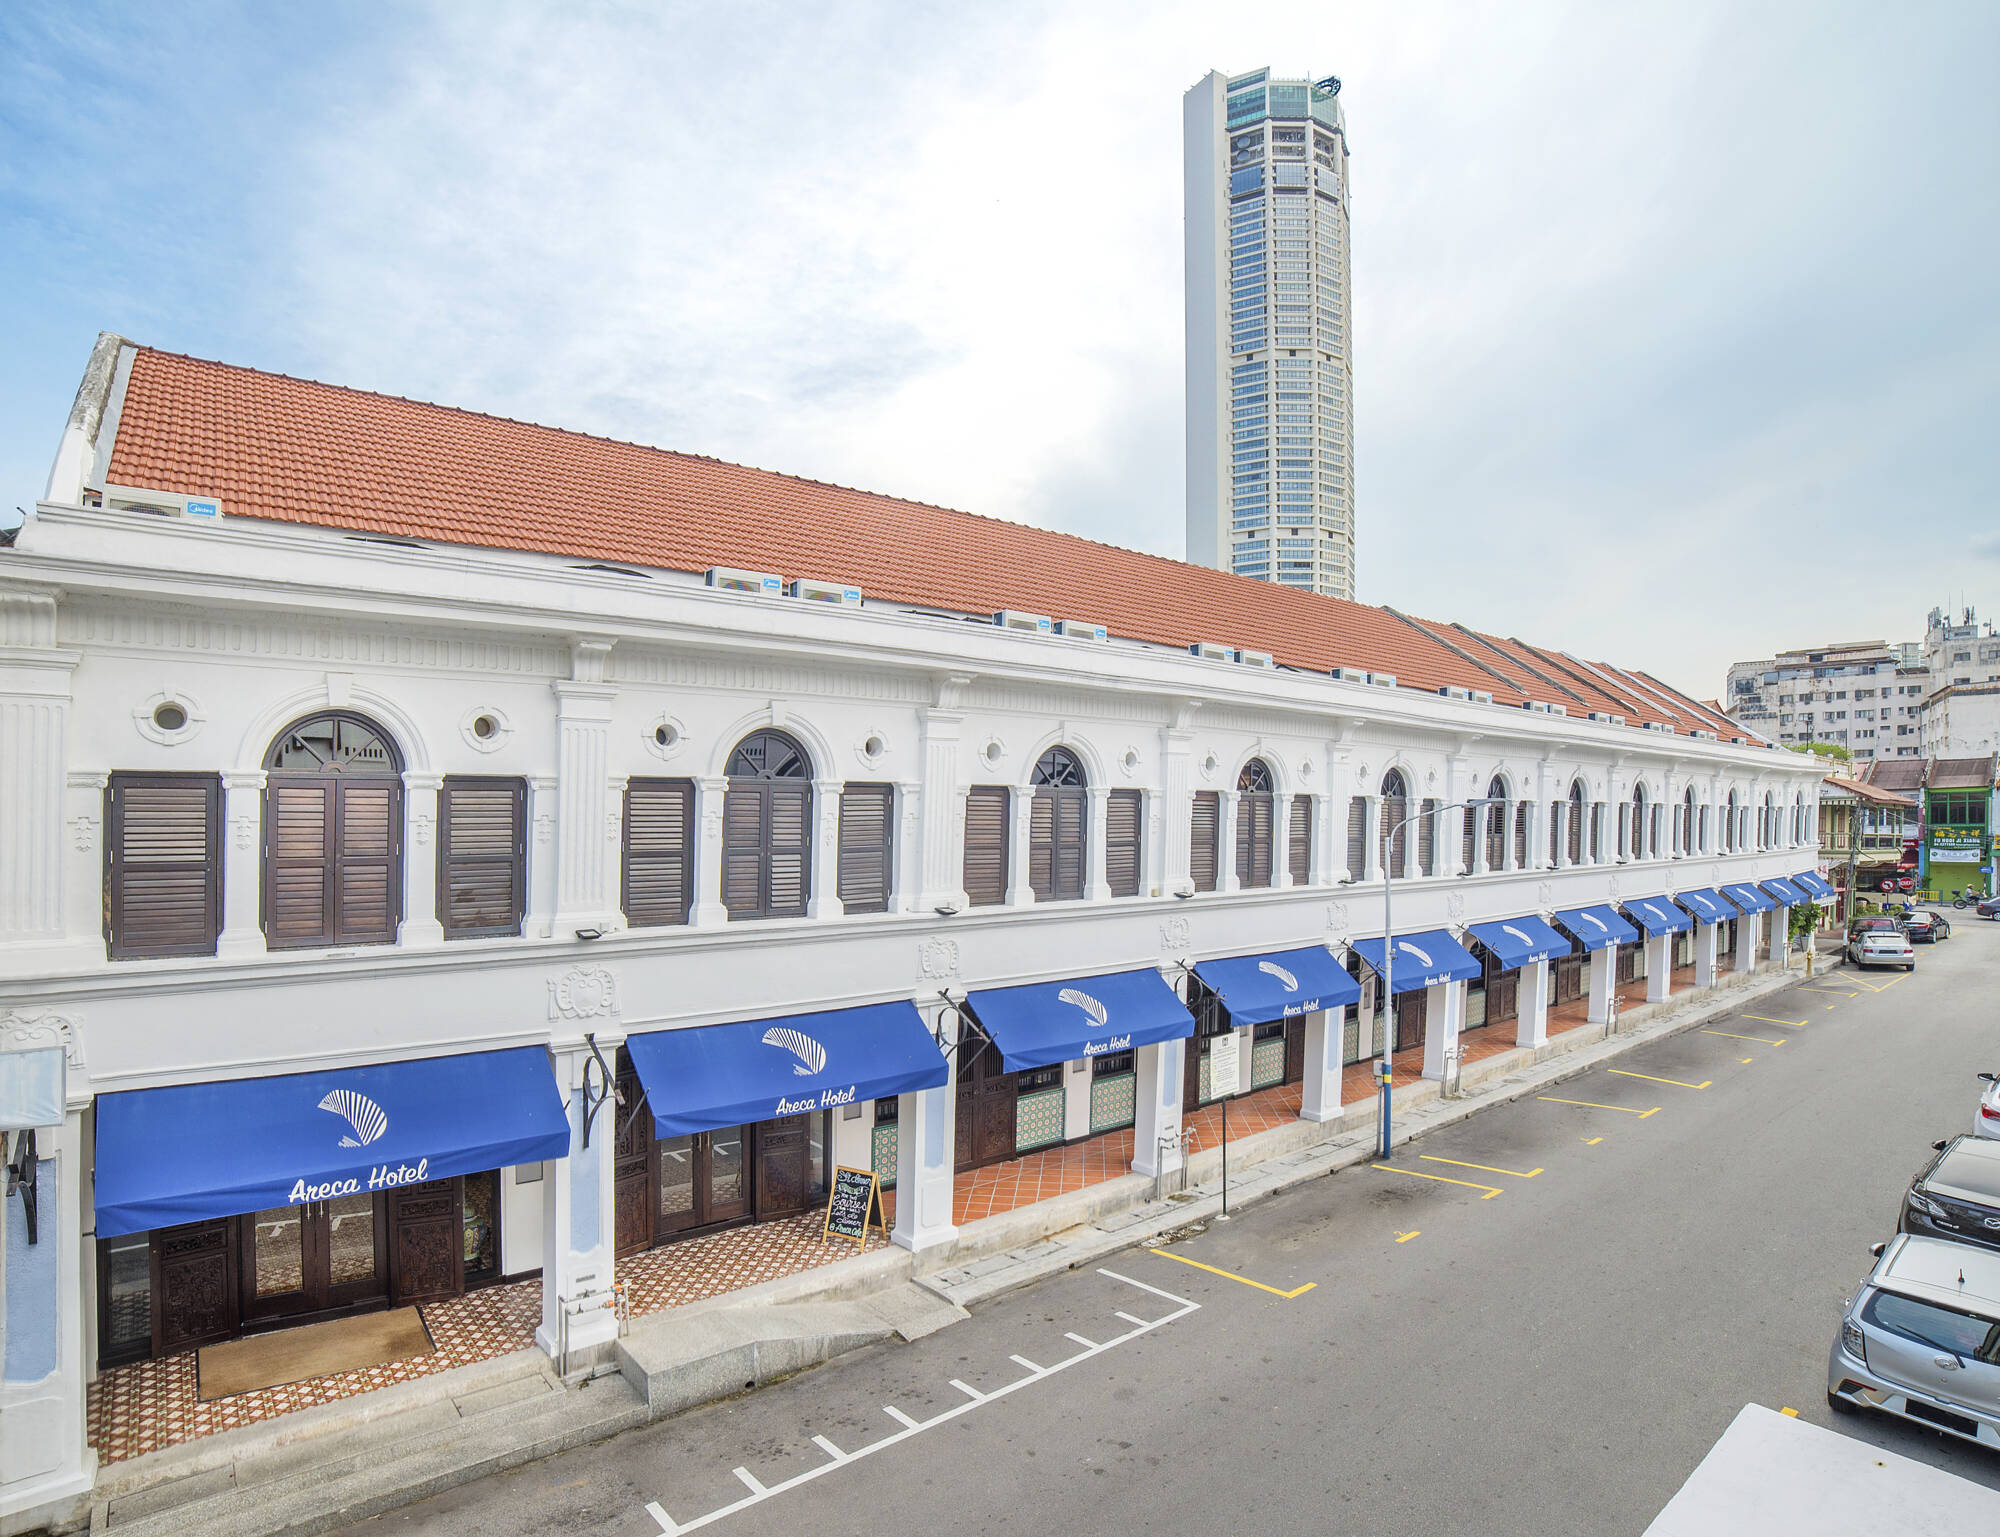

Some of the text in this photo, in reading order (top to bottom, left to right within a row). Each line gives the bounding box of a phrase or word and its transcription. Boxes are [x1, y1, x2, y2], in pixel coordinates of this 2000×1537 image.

[1303, 997, 1319, 1012] Hotel
[1083, 1033, 1131, 1056] Areca Hotel
[776, 1084, 856, 1115] Areca Hotel
[288, 1157, 429, 1203] Areca Hotel
